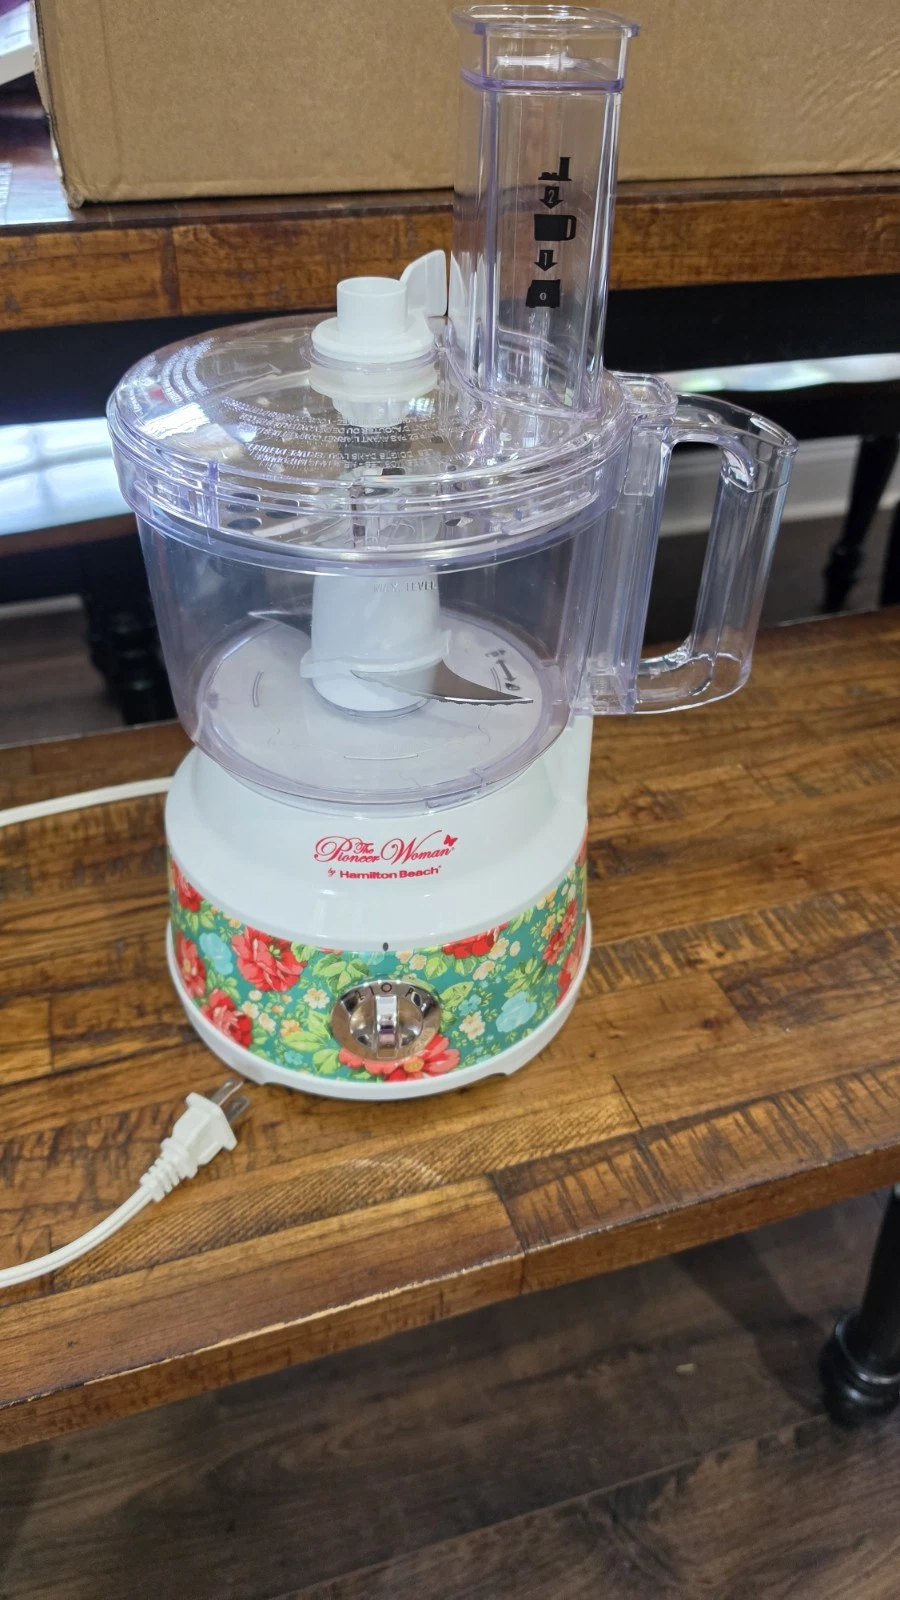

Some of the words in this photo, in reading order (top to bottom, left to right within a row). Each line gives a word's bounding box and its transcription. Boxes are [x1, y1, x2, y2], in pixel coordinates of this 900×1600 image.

[314, 835, 381, 863] Pioneer
[381, 830, 453, 865] Woman
[353, 841, 374, 855] The
[327, 867, 336, 878] by
[339, 870, 398, 880] Hamilton
[399, 867, 440, 878] Beach
[354, 990, 364, 1000] 2
[405, 988, 414, 998] P
